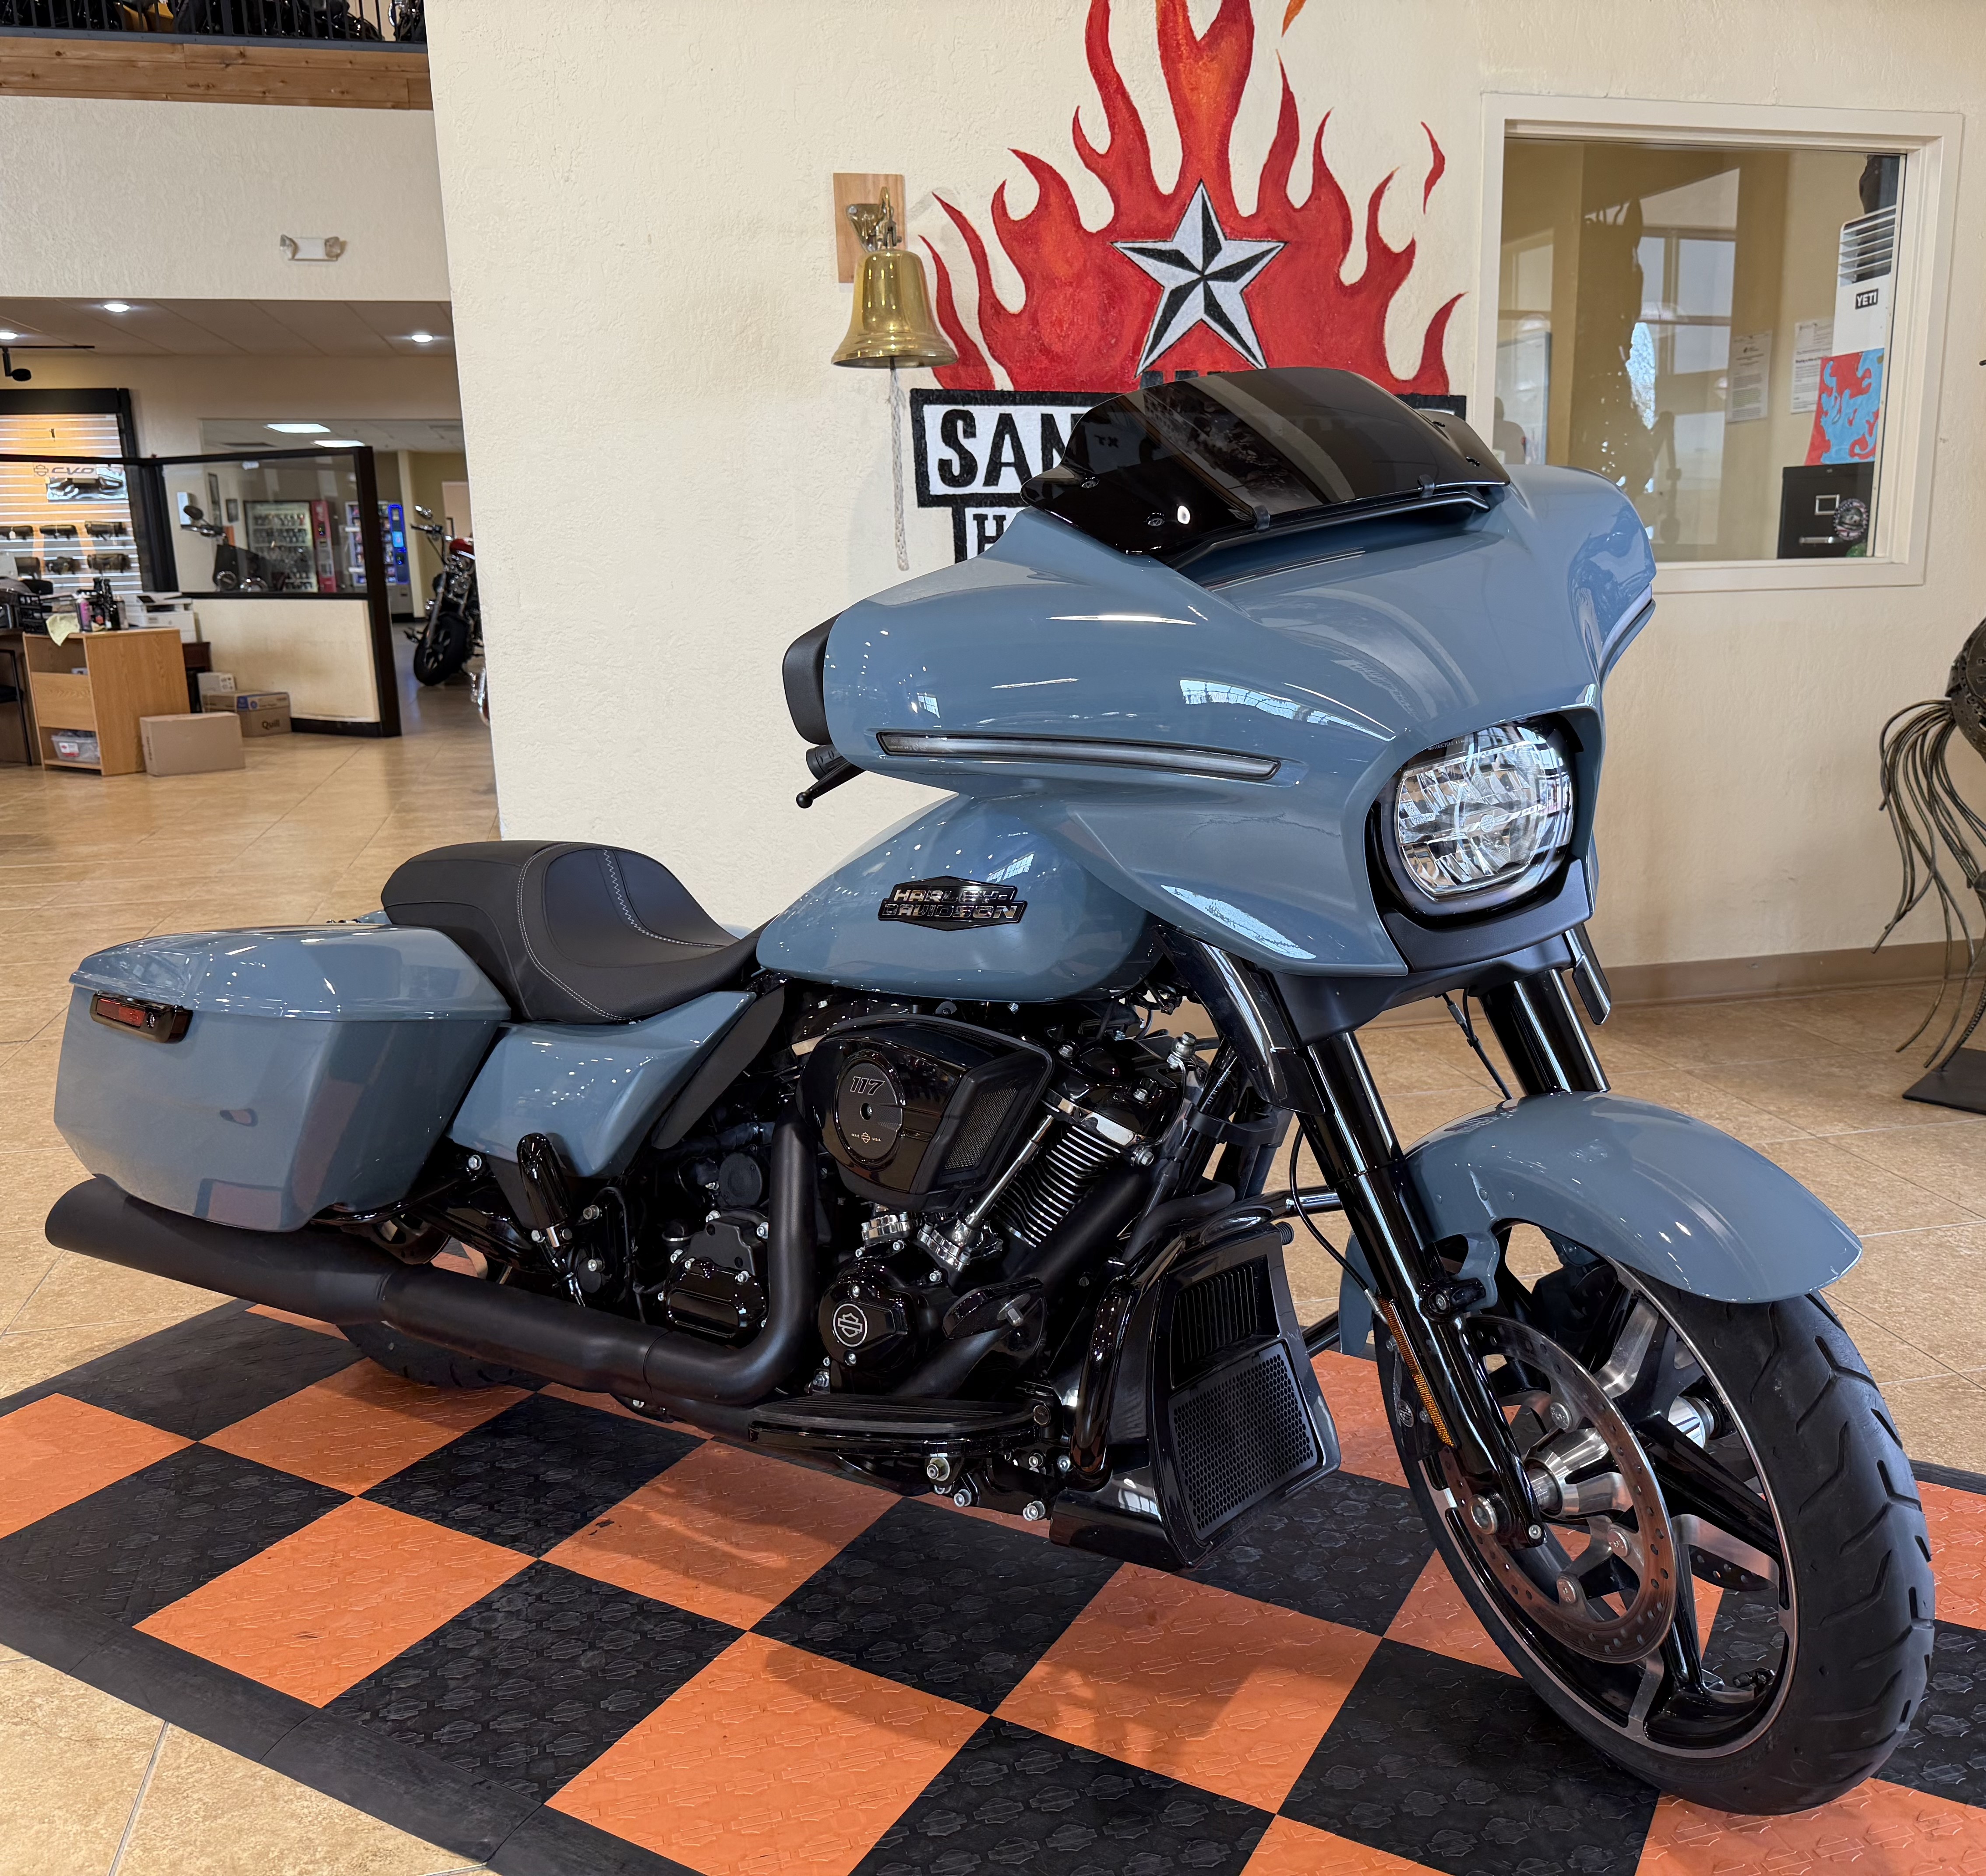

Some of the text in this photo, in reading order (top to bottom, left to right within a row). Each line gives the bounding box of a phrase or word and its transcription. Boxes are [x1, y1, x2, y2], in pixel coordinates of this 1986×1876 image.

[1857, 291, 1877, 307] YETI
[262, 719, 280, 730] Quill
[882, 903, 1018, 919] DAVIDSON
[850, 1076, 885, 1096] 117
